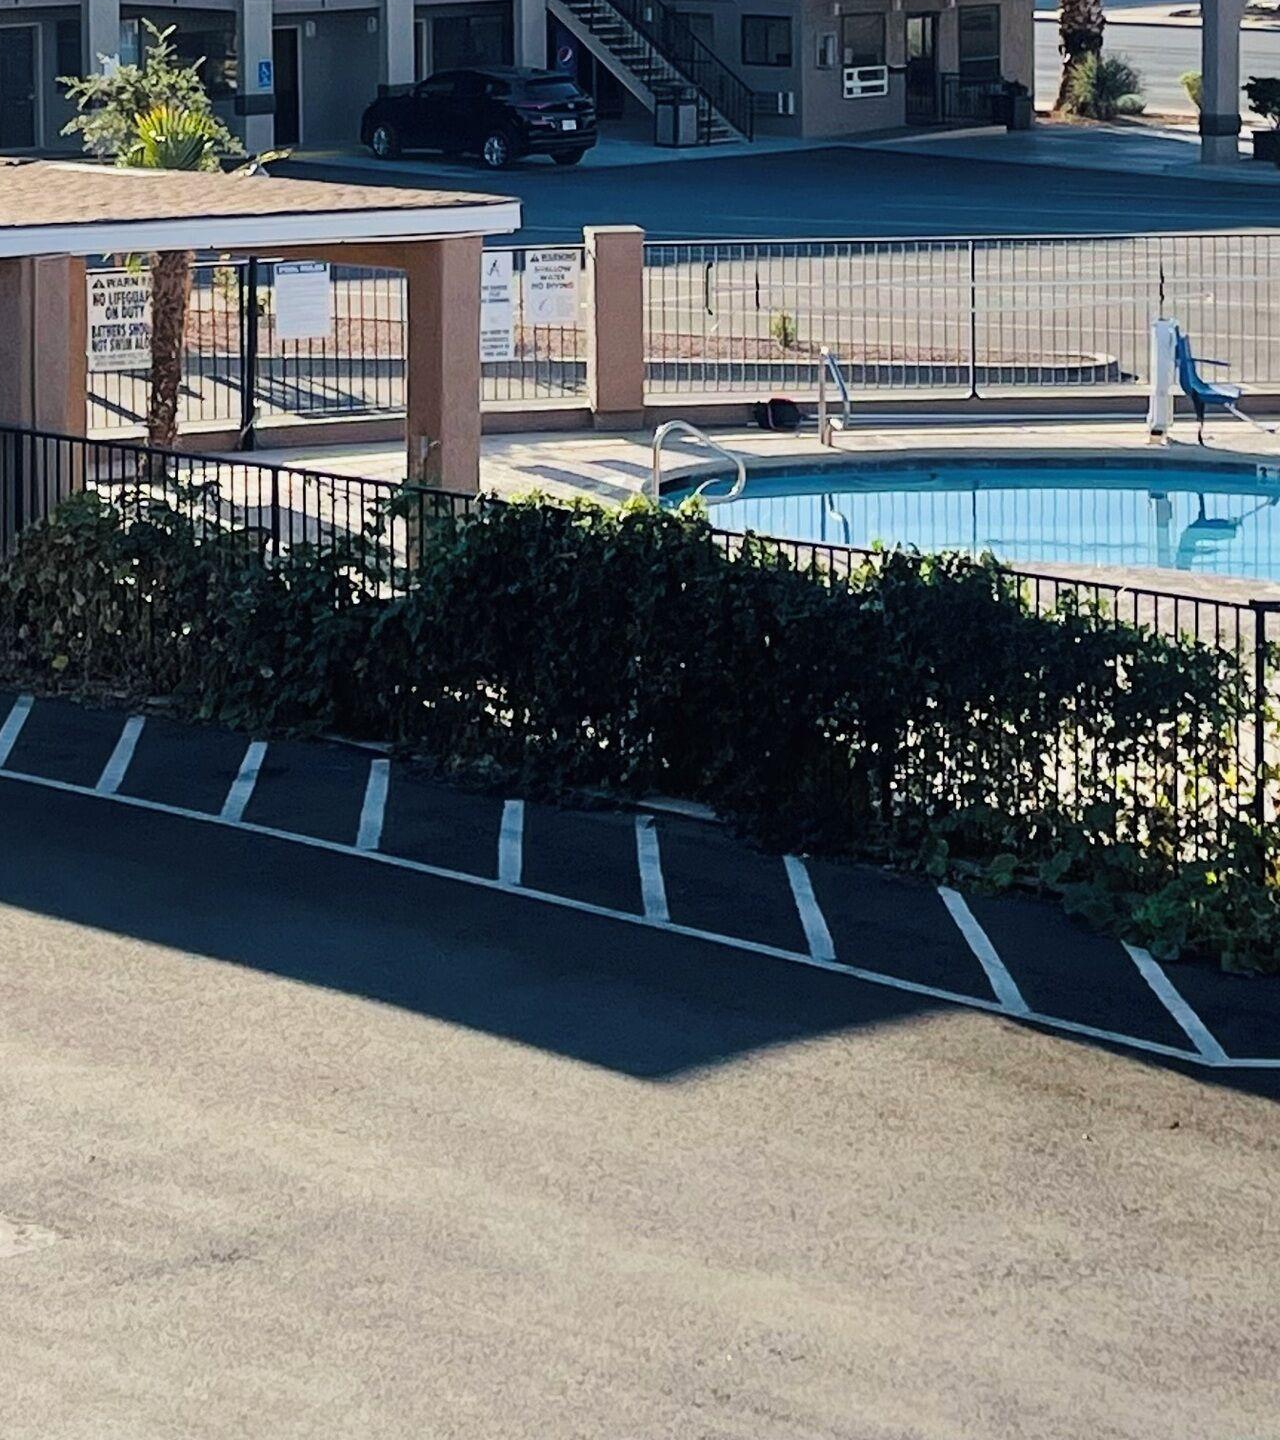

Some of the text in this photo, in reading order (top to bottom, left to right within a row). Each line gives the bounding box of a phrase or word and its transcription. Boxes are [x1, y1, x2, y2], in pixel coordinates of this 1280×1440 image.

[93, 291, 152, 307] NO LIFEGUAR
[105, 305, 145, 320] ON DUTY
[91, 338, 108, 353] NOT
[109, 337, 133, 352] SWIM
